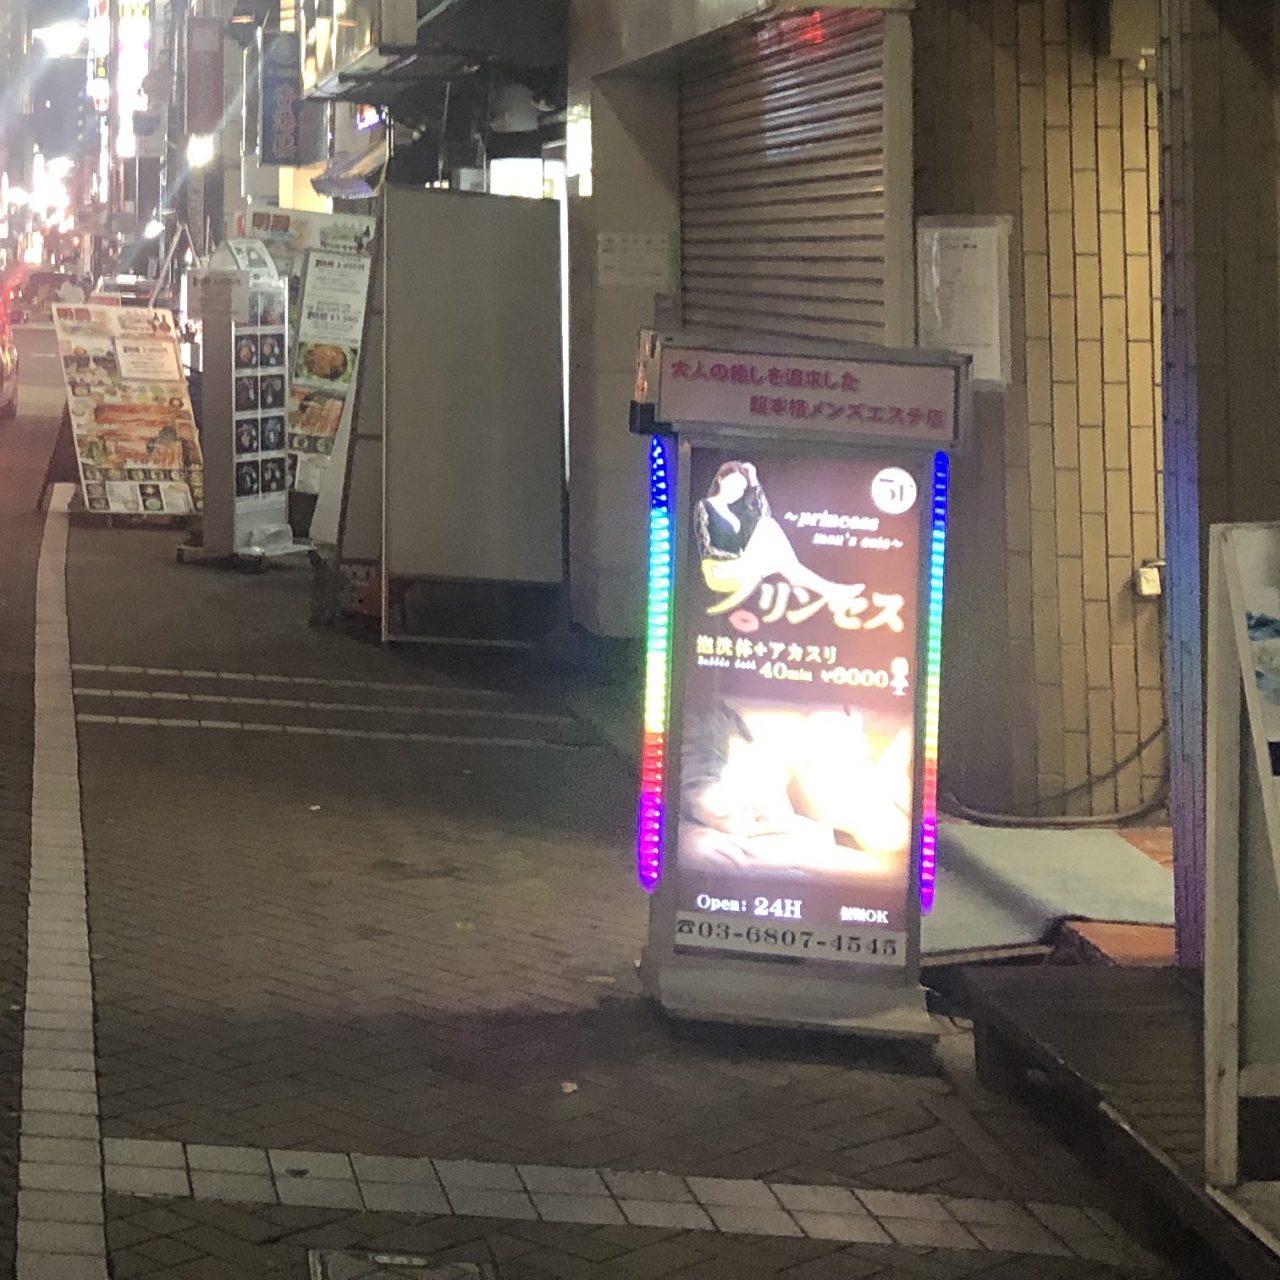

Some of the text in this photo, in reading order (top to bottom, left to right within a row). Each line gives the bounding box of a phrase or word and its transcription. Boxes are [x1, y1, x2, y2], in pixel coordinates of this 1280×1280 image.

[697, 893, 803, 919] Open: 24H
[698, 921, 898, 956] 03-6807-4545
